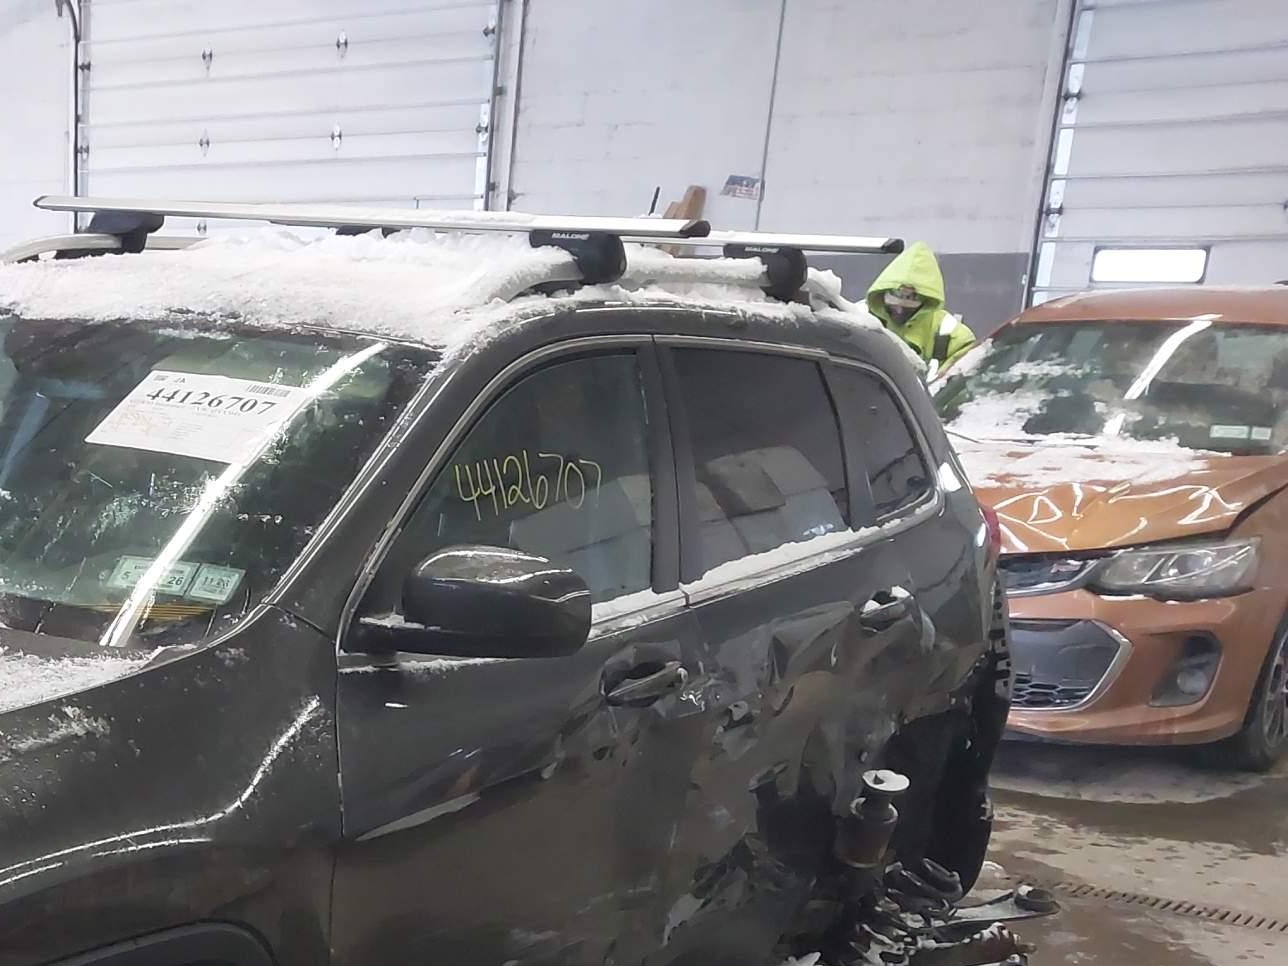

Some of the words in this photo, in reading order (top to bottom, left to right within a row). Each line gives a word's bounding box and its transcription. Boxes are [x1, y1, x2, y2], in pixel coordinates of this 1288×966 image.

[146, 387, 278, 415] 44126707
[455, 450, 602, 521] 44126707
[167, 576, 184, 586] 26
